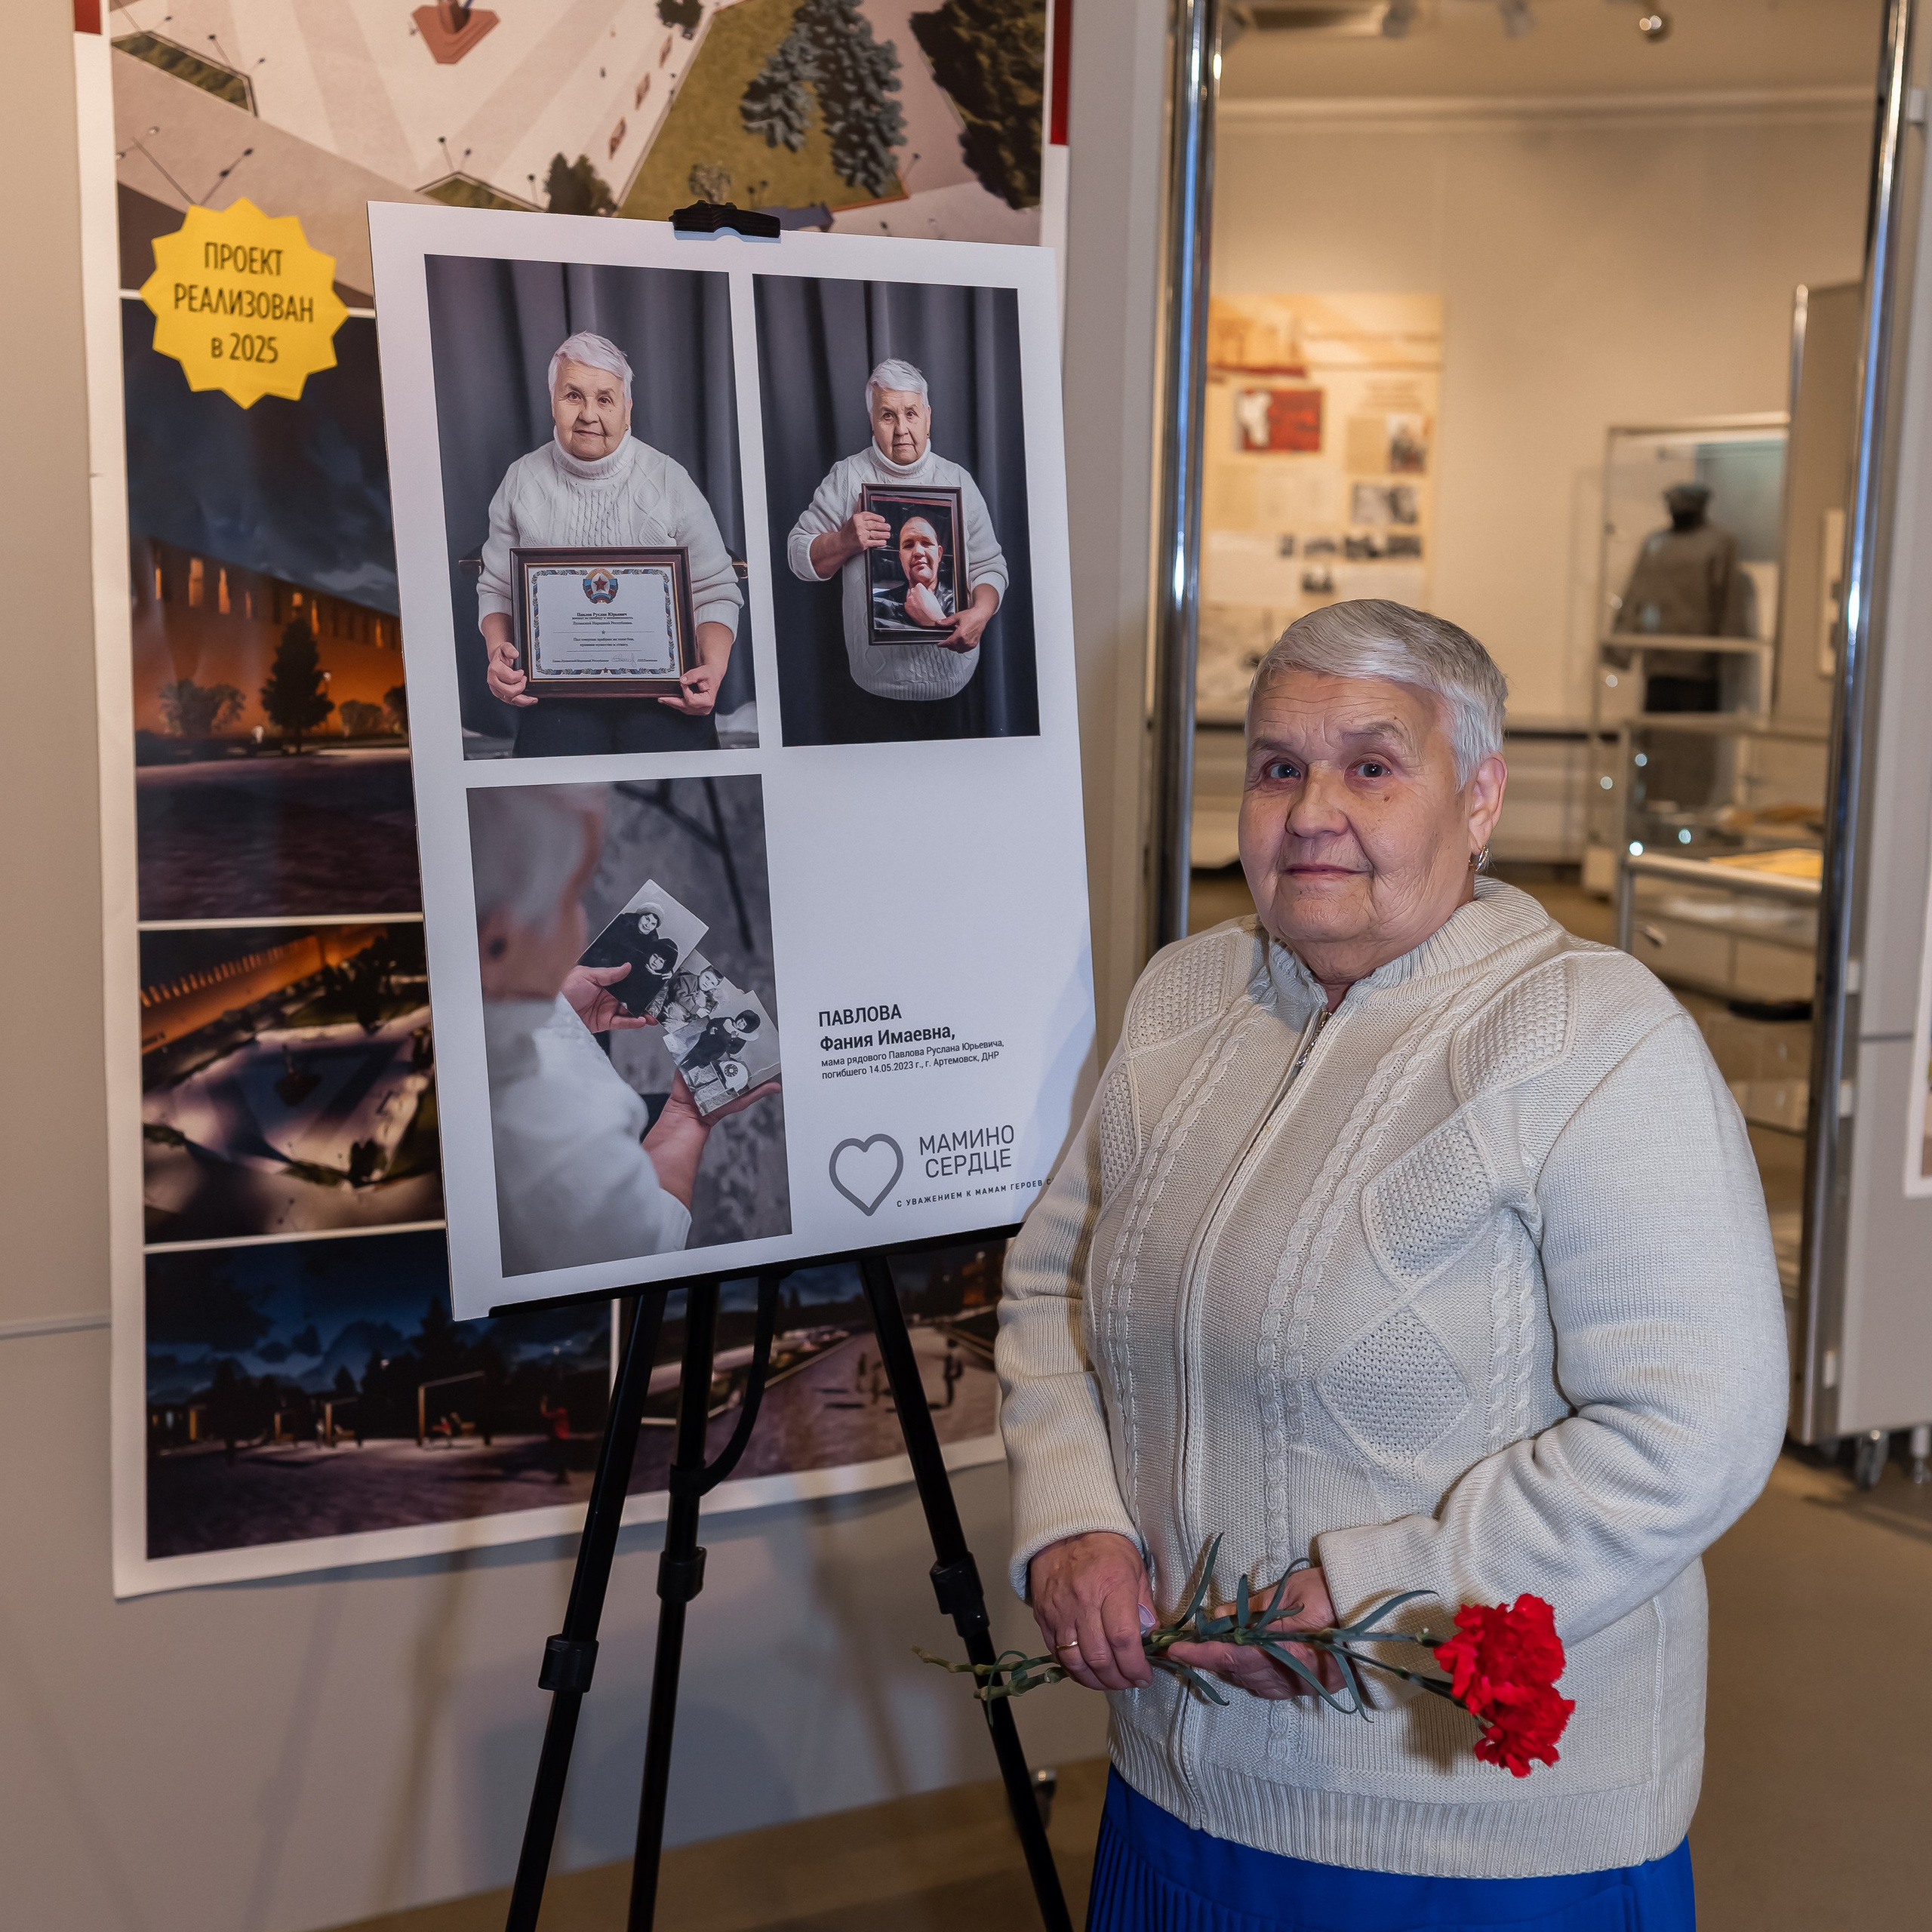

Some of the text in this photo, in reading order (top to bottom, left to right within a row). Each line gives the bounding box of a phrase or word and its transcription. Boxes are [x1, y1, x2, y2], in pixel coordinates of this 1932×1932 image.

[205, 242, 283, 275] ПРОЕКТ
[174, 283, 314, 323] РЕАЛИЗОВАН
[229, 332, 278, 364] 2025
[818, 1004, 903, 1027] ПАВЛОВА
[820, 1025, 955, 1051] Фания Имаевна,
[821, 1039, 1004, 1067] мама рядового Павлова Руслана Юрьевича,
[822, 1051, 1000, 1080] погибшего 14.05.2023 г., г. Артемовск, ДНР
[918, 1124, 1015, 1155] МАМИНО
[924, 1147, 1013, 1178] СЕРДЦЕ
[906, 1192, 963, 1206] УВАЖЕНИЕМ
[975, 1184, 1008, 1195] МАМАМ
[1010, 1180, 1043, 1191] ГЕРОЕВ
